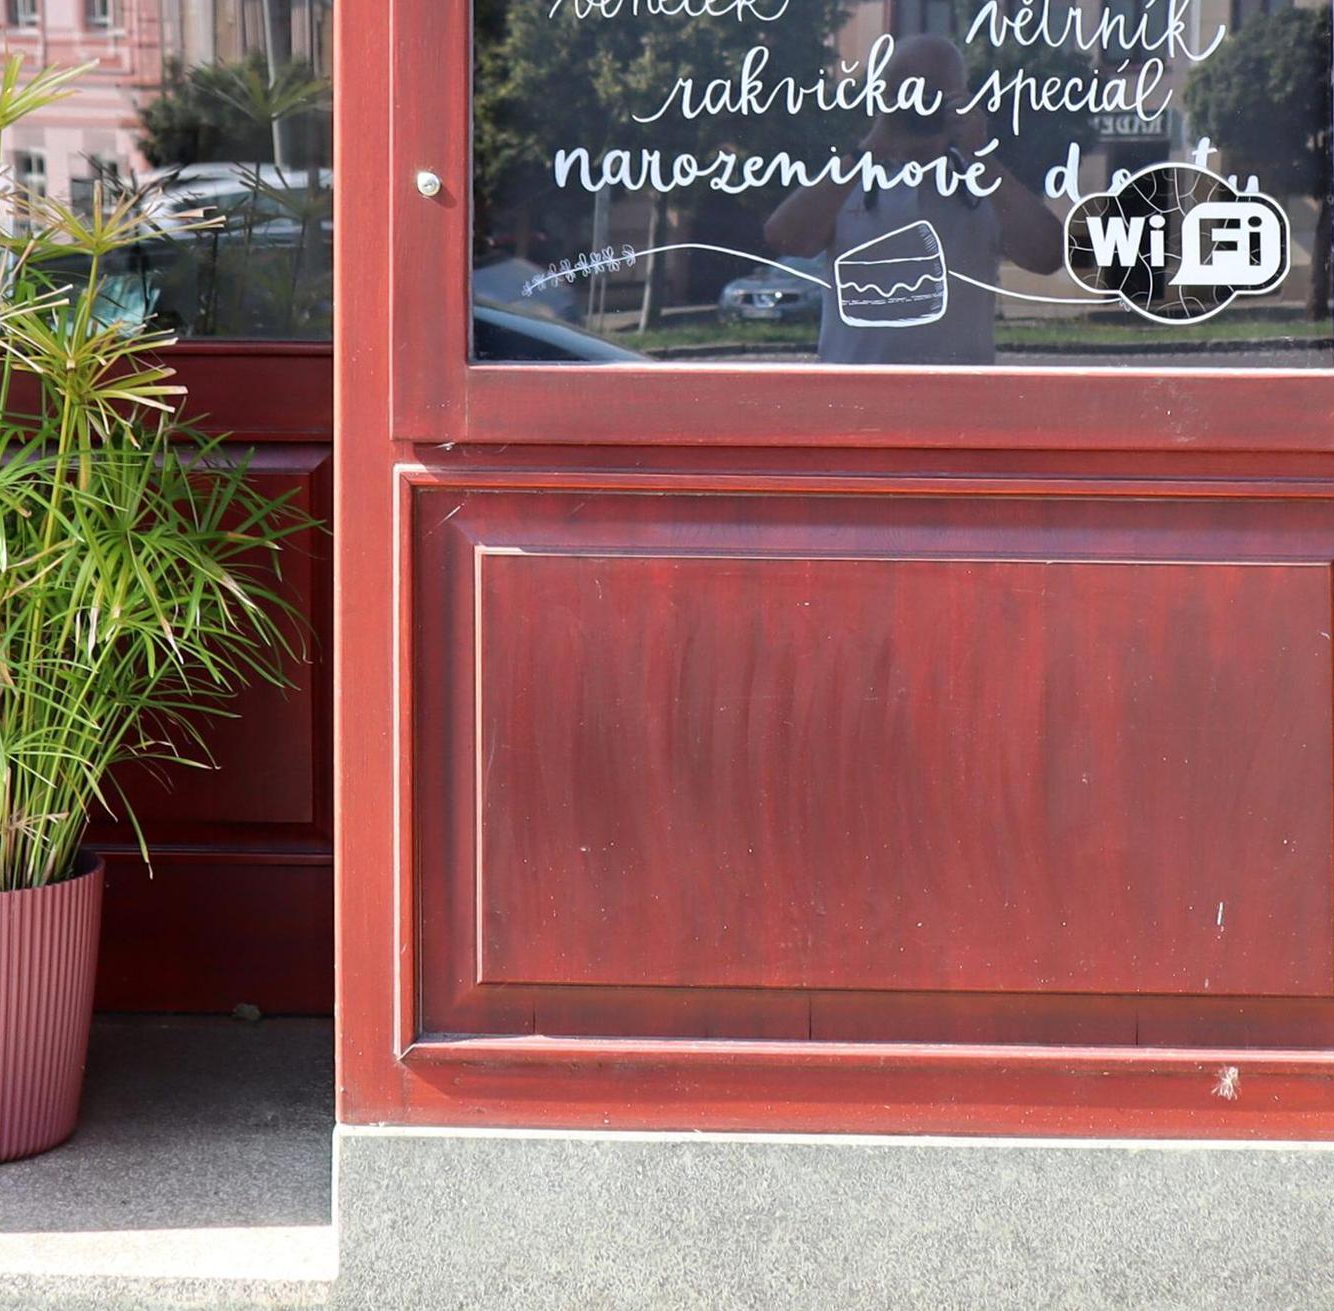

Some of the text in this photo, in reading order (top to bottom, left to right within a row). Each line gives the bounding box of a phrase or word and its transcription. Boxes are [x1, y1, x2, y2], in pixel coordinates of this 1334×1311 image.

[632, 34, 1172, 132] rakvička speciál
[554, 136, 1003, 199] narozeninové
